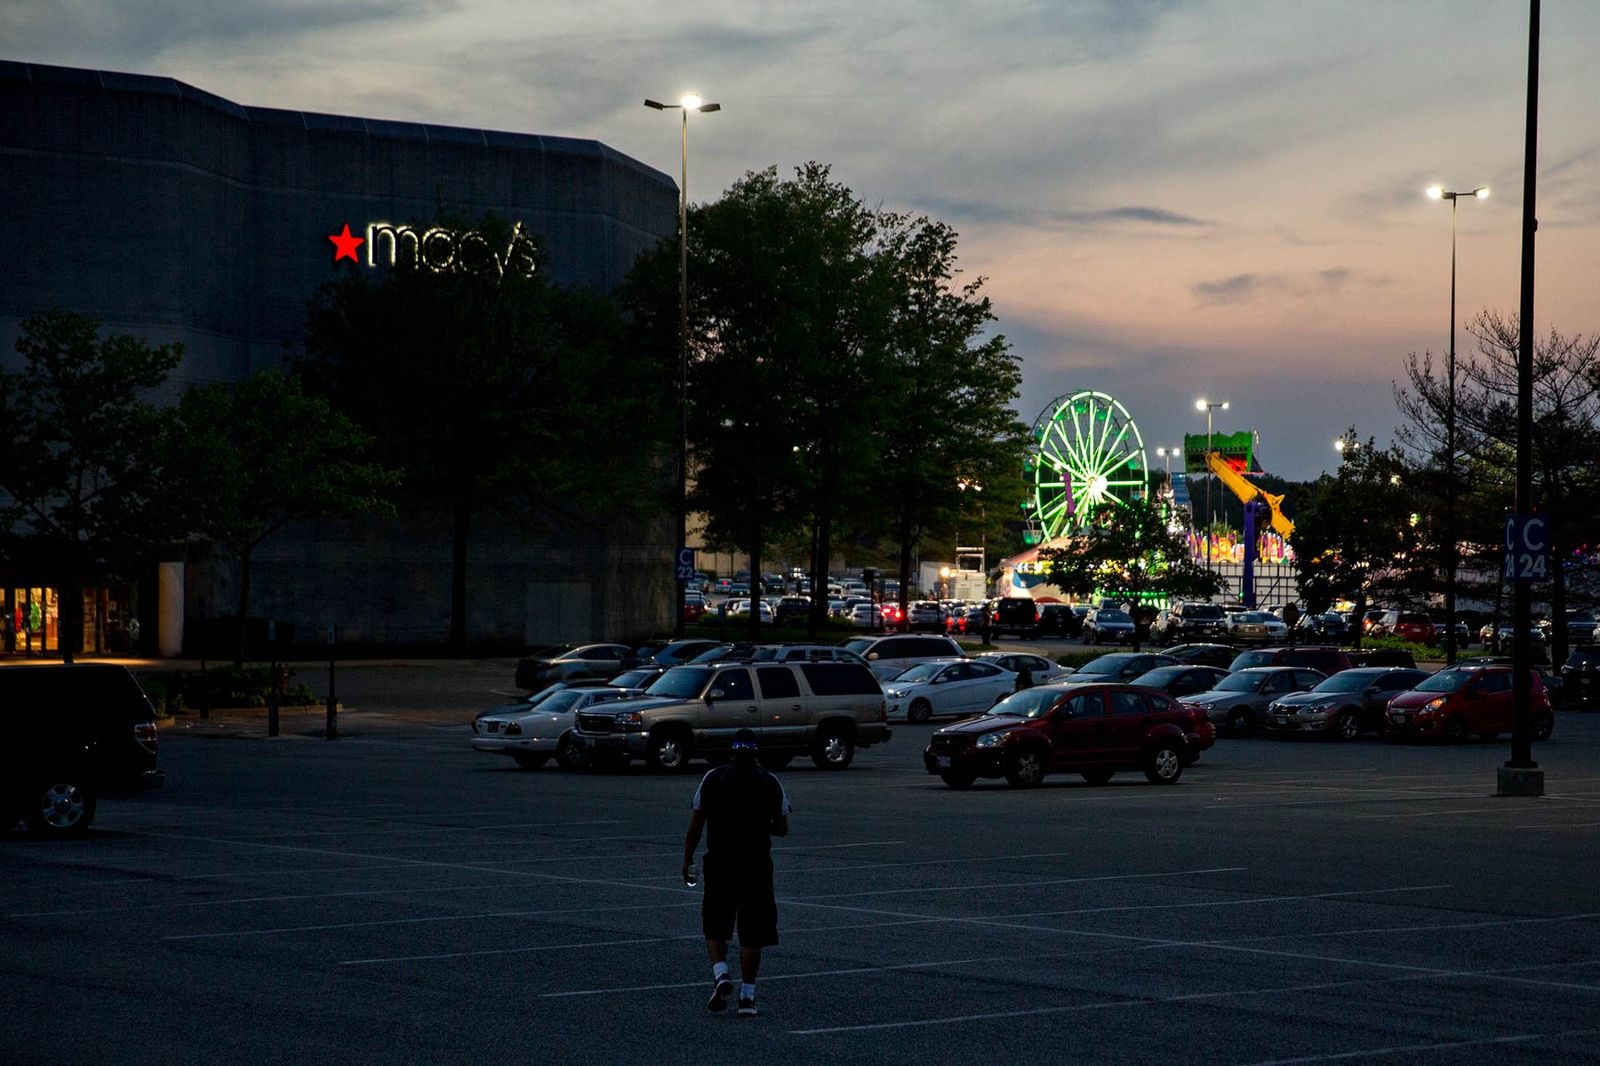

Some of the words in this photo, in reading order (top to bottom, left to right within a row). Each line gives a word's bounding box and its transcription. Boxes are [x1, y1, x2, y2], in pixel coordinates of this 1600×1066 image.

[365, 220, 539, 283] macy's
[1522, 518, 1545, 551] C
[679, 548, 693, 565] C
[1519, 553, 1547, 578] 24
[677, 566, 694, 579] 22
